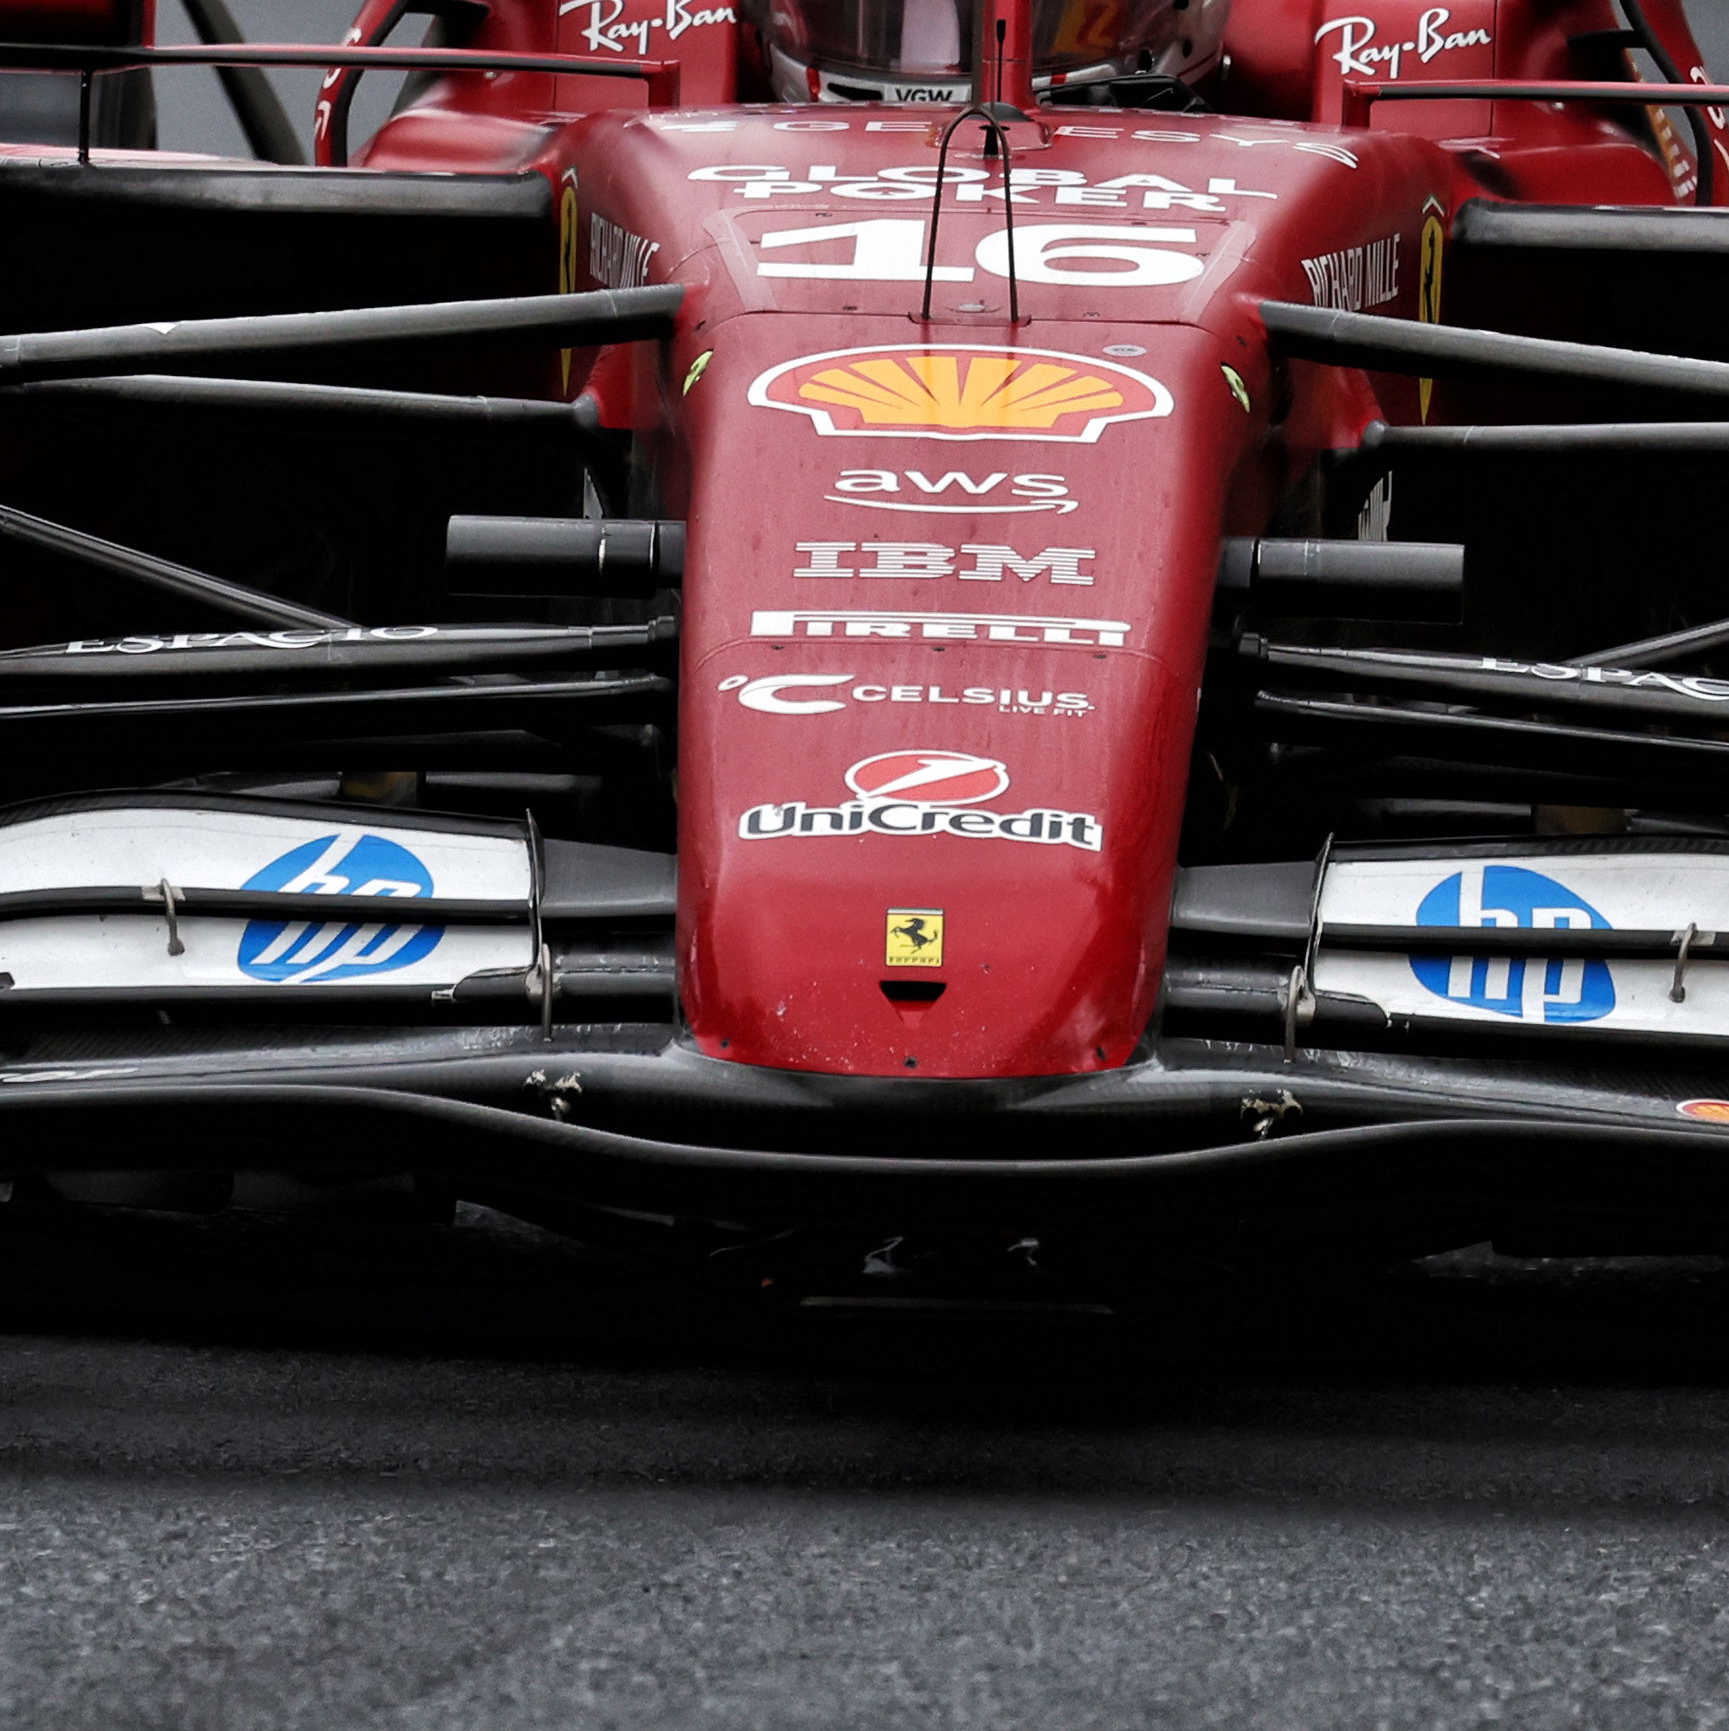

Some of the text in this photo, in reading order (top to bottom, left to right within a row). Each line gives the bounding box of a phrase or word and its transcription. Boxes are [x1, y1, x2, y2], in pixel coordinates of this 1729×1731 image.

[1315, 8, 1490, 79] Ray-Ban
[895, 89, 953, 102] VGW
[773, 120, 1359, 169] GEESYS
[687, 164, 1278, 200] GLOBAL
[733, 181, 1227, 213] POKER
[756, 218, 1205, 287] 16
[834, 469, 1070, 498] aws
[793, 541, 1097, 586] IBM
[750, 610, 1132, 647] PIRELLI
[998, 704, 1088, 718] LIVE FIT
[746, 802, 1096, 846] UniCredit
[250, 833, 426, 983] hp
[1446, 864, 1594, 1023] hp
